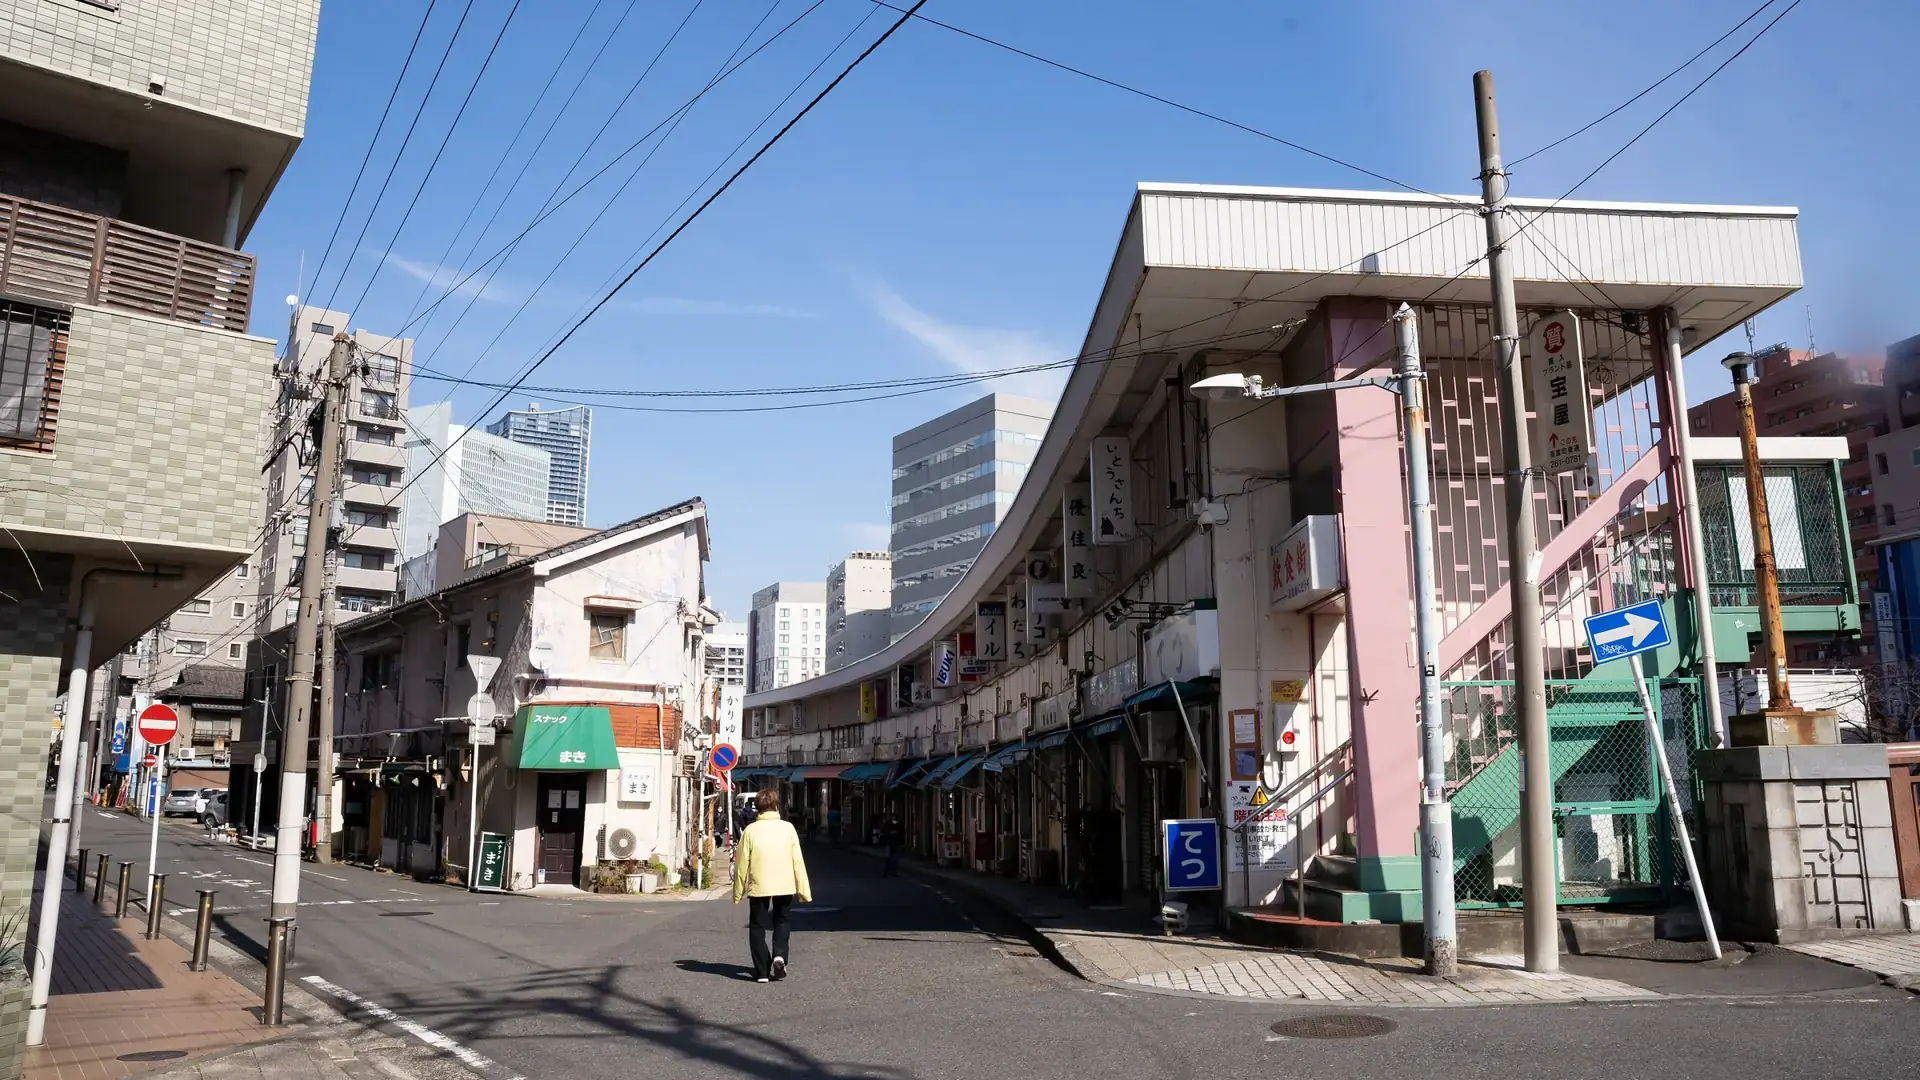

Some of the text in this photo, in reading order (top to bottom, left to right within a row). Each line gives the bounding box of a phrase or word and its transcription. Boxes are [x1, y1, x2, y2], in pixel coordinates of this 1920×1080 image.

[1550, 375, 1570, 427] 宝屋
[1550, 453, 1582, 469] 261-0781
[1106, 444, 1125, 520] いとうさんち
[1272, 540, 1307, 593] 飲食街
[936, 649, 956, 685] IBUKI
[533, 714, 568, 724] スナック
[559, 750, 587, 764] まき
[628, 782, 648, 795] まき
[483, 851, 497, 881] まき
[1180, 830, 1206, 880] てつ
